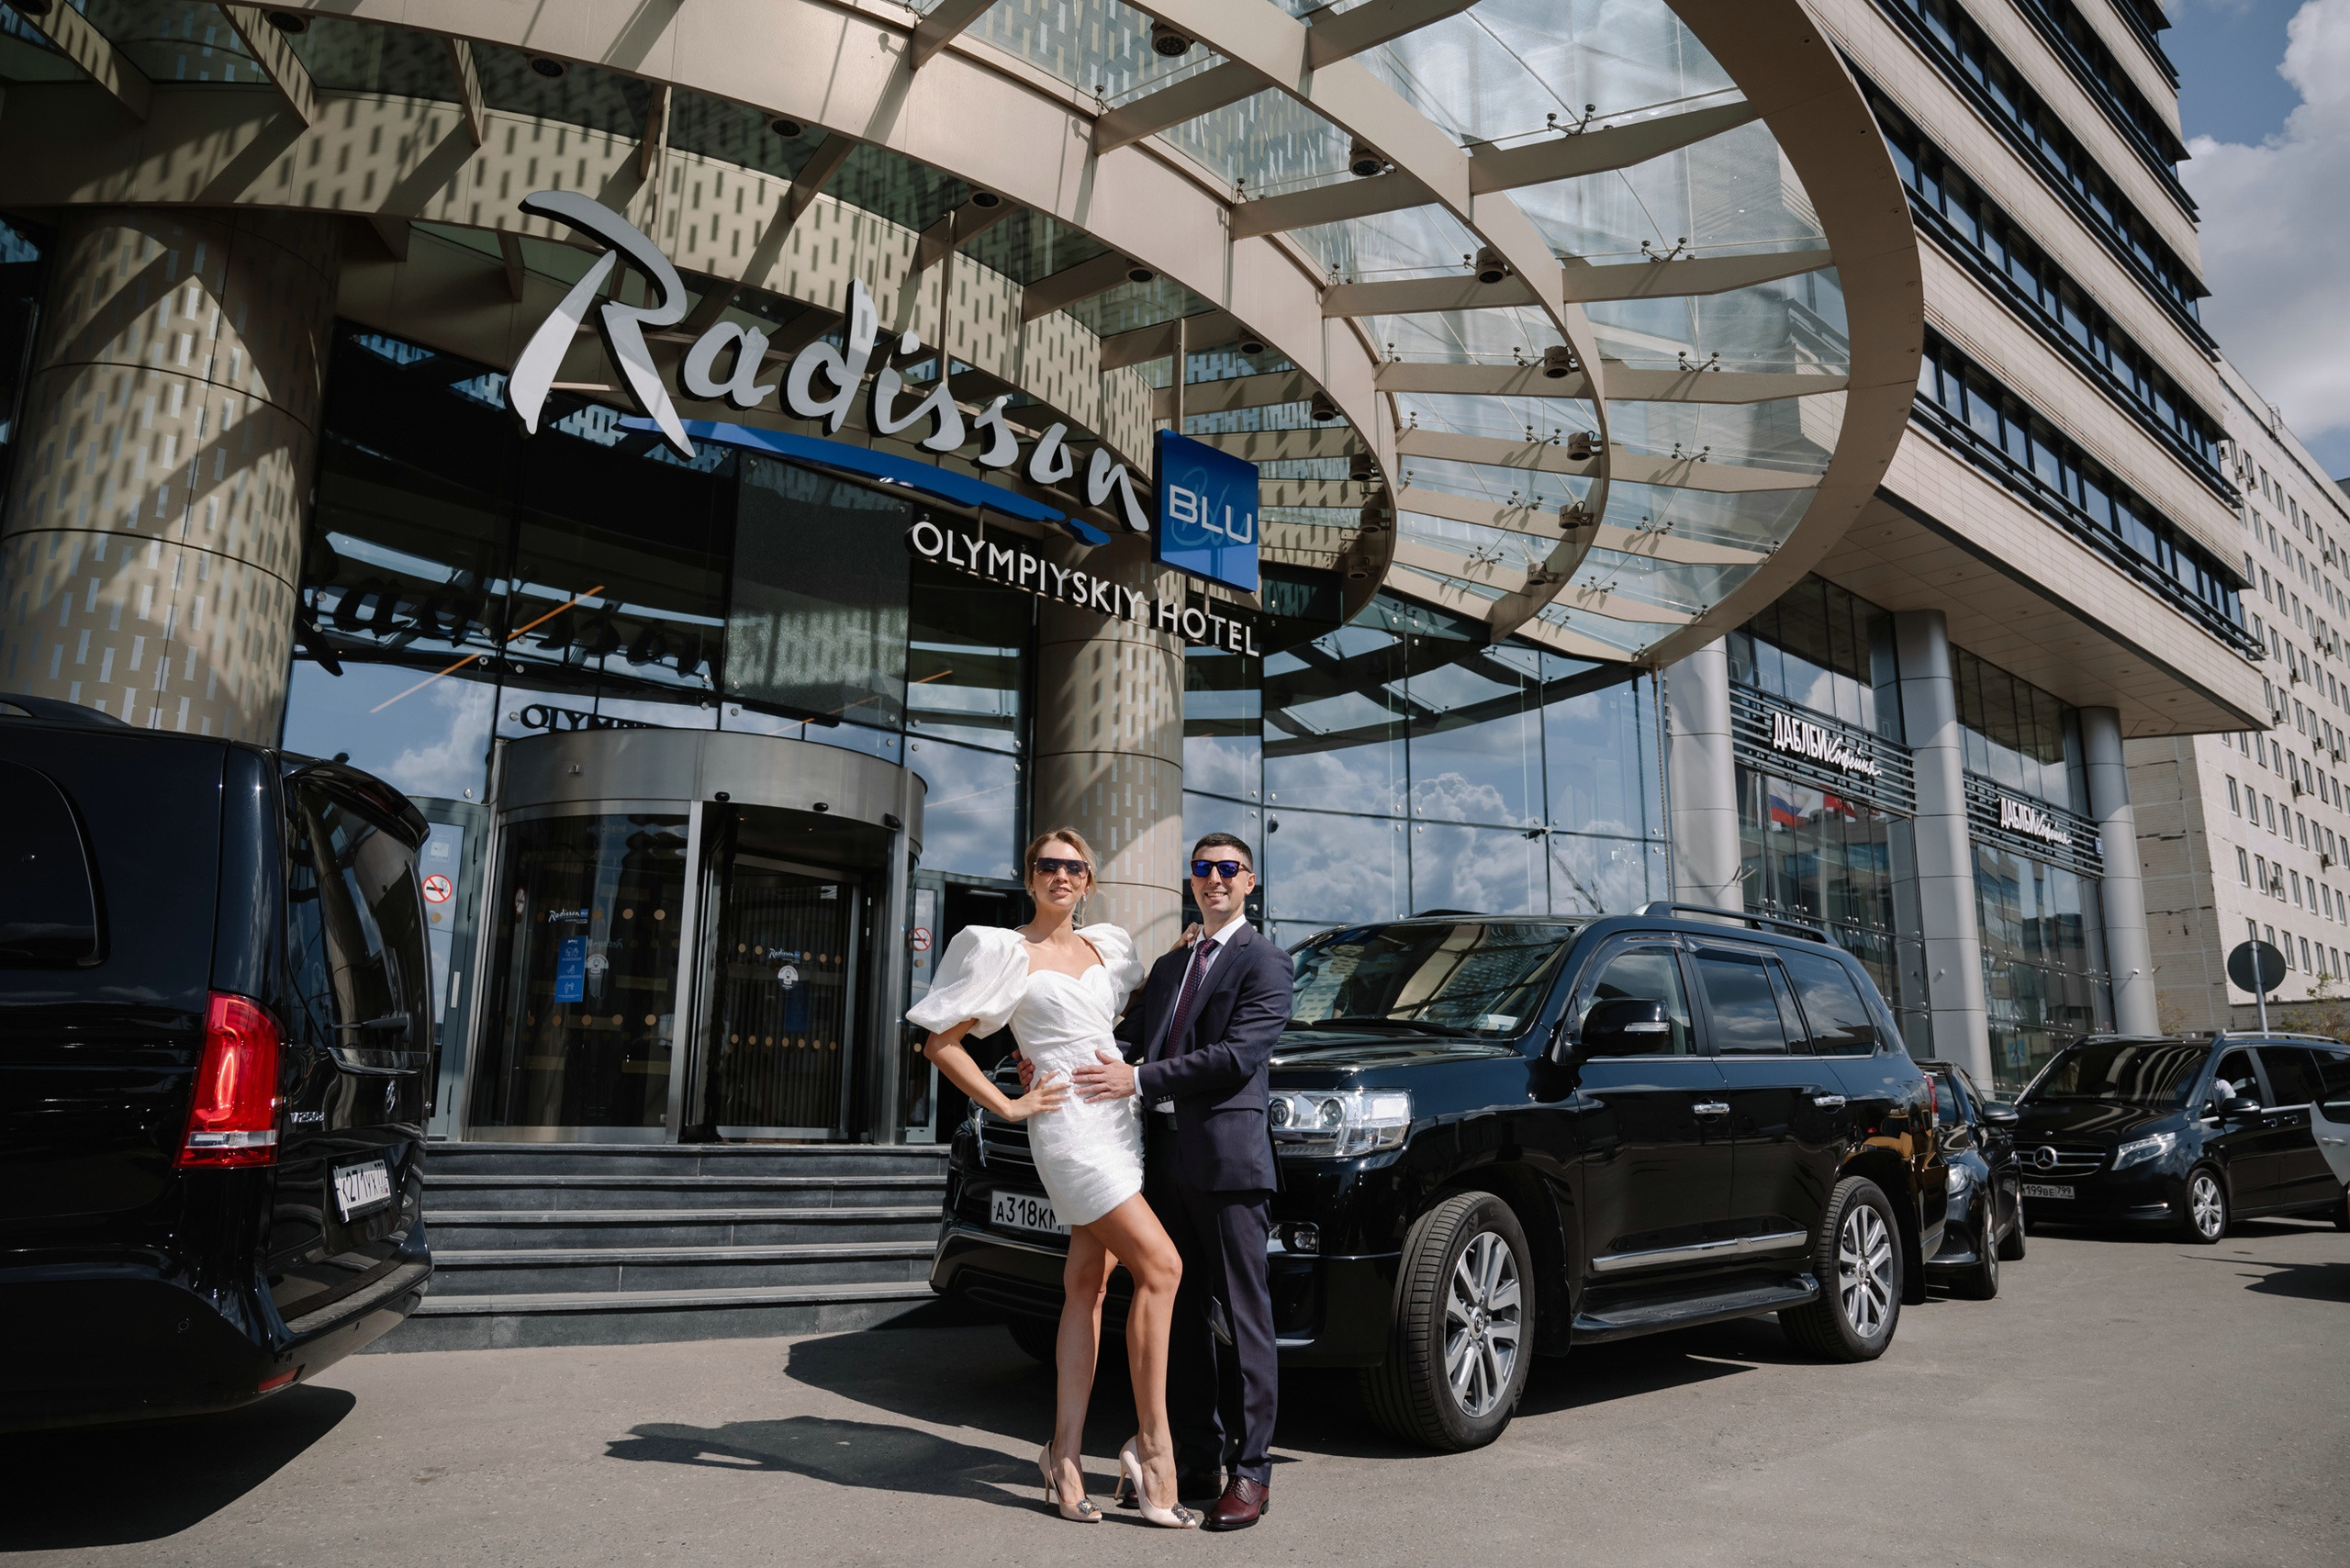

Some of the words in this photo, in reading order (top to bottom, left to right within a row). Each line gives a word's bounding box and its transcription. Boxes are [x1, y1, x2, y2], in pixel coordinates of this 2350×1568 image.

[506, 190, 1150, 532] Radisson
[1169, 484, 1252, 544] BLU
[911, 521, 1144, 620] OLYMPIYSKIY
[1158, 598, 1260, 657] HOTEL
[1773, 711, 1830, 763] ДАБЛБИ
[2000, 797, 2037, 836] ДАБЛБИ
